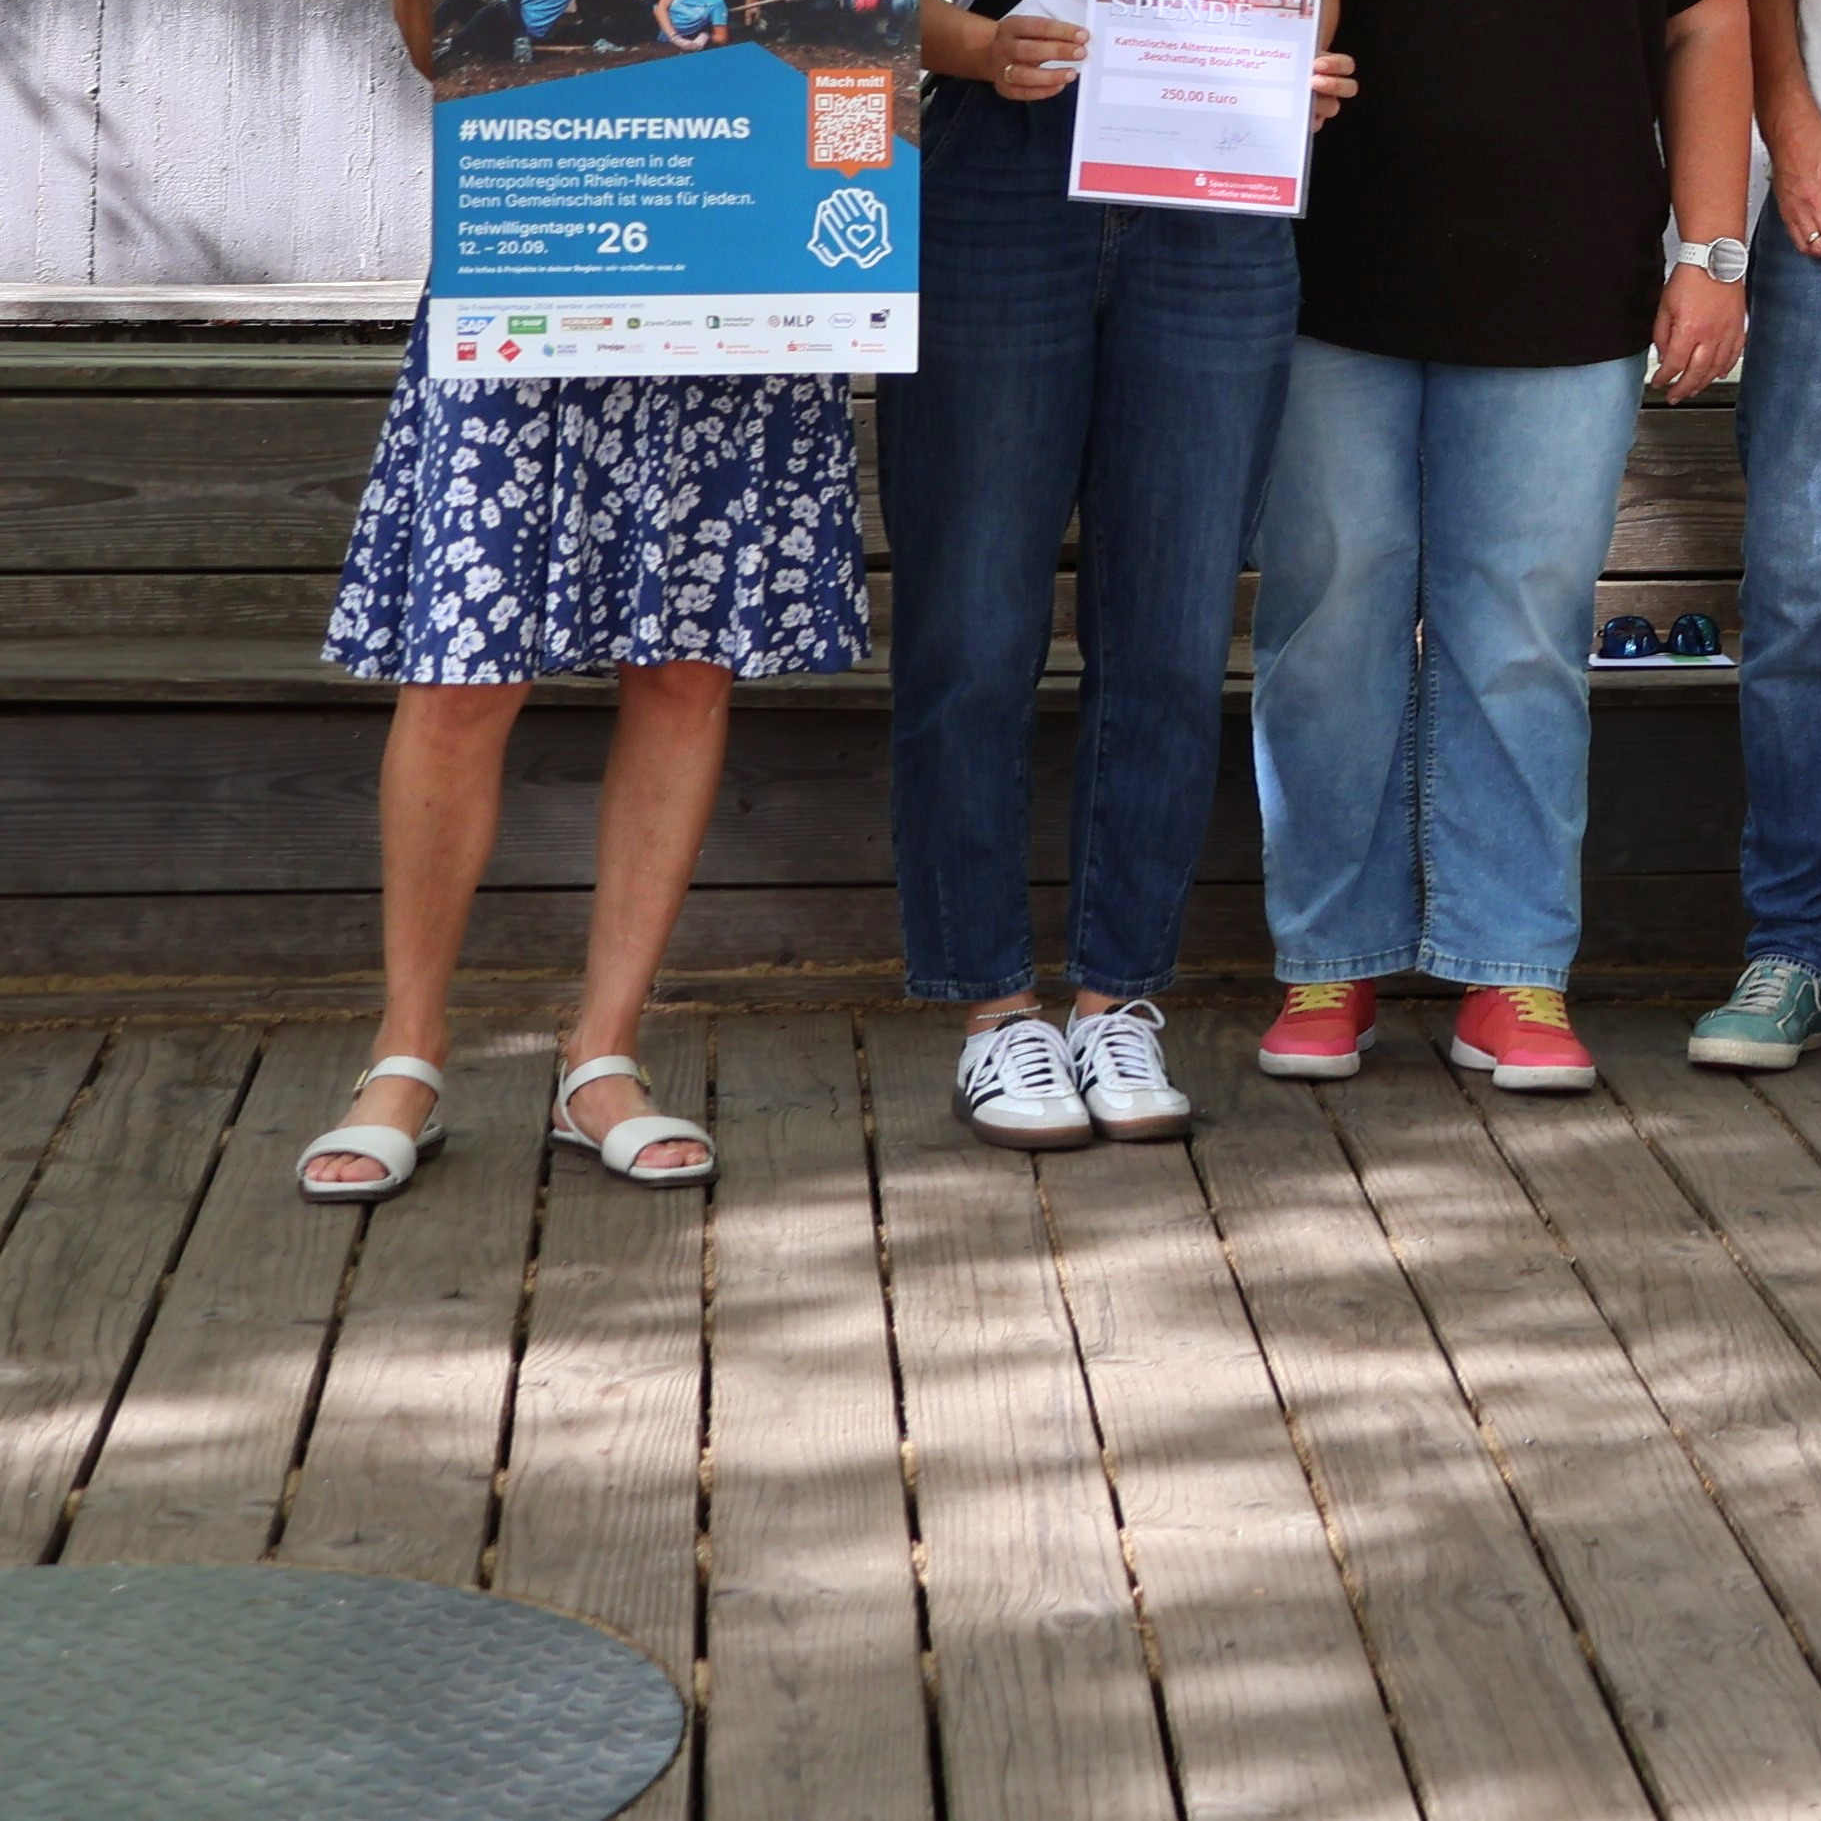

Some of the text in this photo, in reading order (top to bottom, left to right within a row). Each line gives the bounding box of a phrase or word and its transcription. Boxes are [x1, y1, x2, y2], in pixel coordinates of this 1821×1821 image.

[1114, 35, 1178, 51] Katholisches
[1253, 48, 1292, 60] Landau
[815, 75, 885, 88] Mach mit!
[1161, 88, 1238, 105] 250,00 Euro
[458, 116, 751, 141] #WIRSCHAFFENWAS
[459, 154, 694, 172] Gemeinsam engagieren in der
[459, 172, 695, 191] Metropolregion Rhein-Neckar.
[459, 191, 756, 209] Denn Gemeinschaft ist was für jede:n.
[458, 221, 585, 238] Freiwilligentage
[459, 241, 481, 256] 12.
[497, 240, 549, 256] 20.09.
[782, 315, 815, 328] MLP
